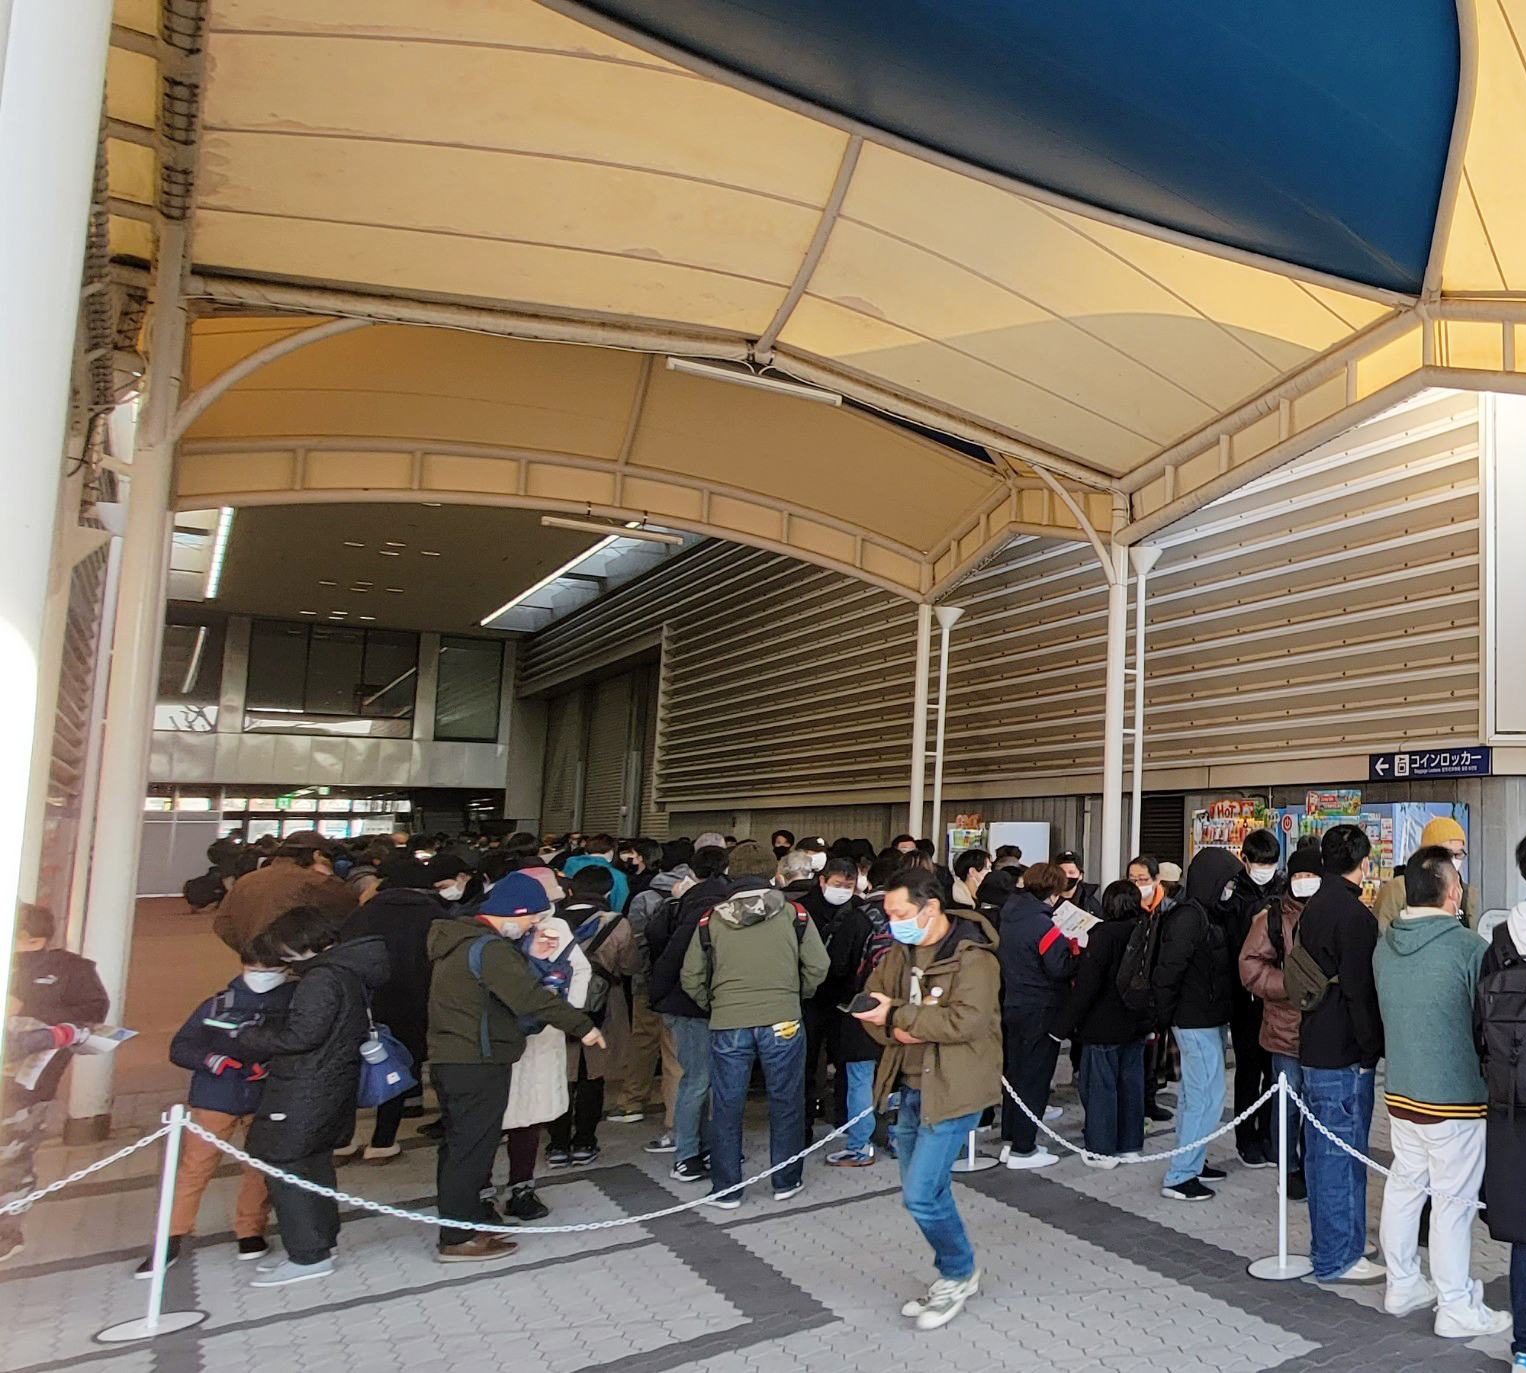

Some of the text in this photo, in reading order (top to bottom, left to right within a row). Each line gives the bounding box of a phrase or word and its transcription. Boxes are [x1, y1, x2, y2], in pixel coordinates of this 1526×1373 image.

[1411, 751, 1482, 768] コインロッカー
[1218, 804, 1236, 819] HOT
